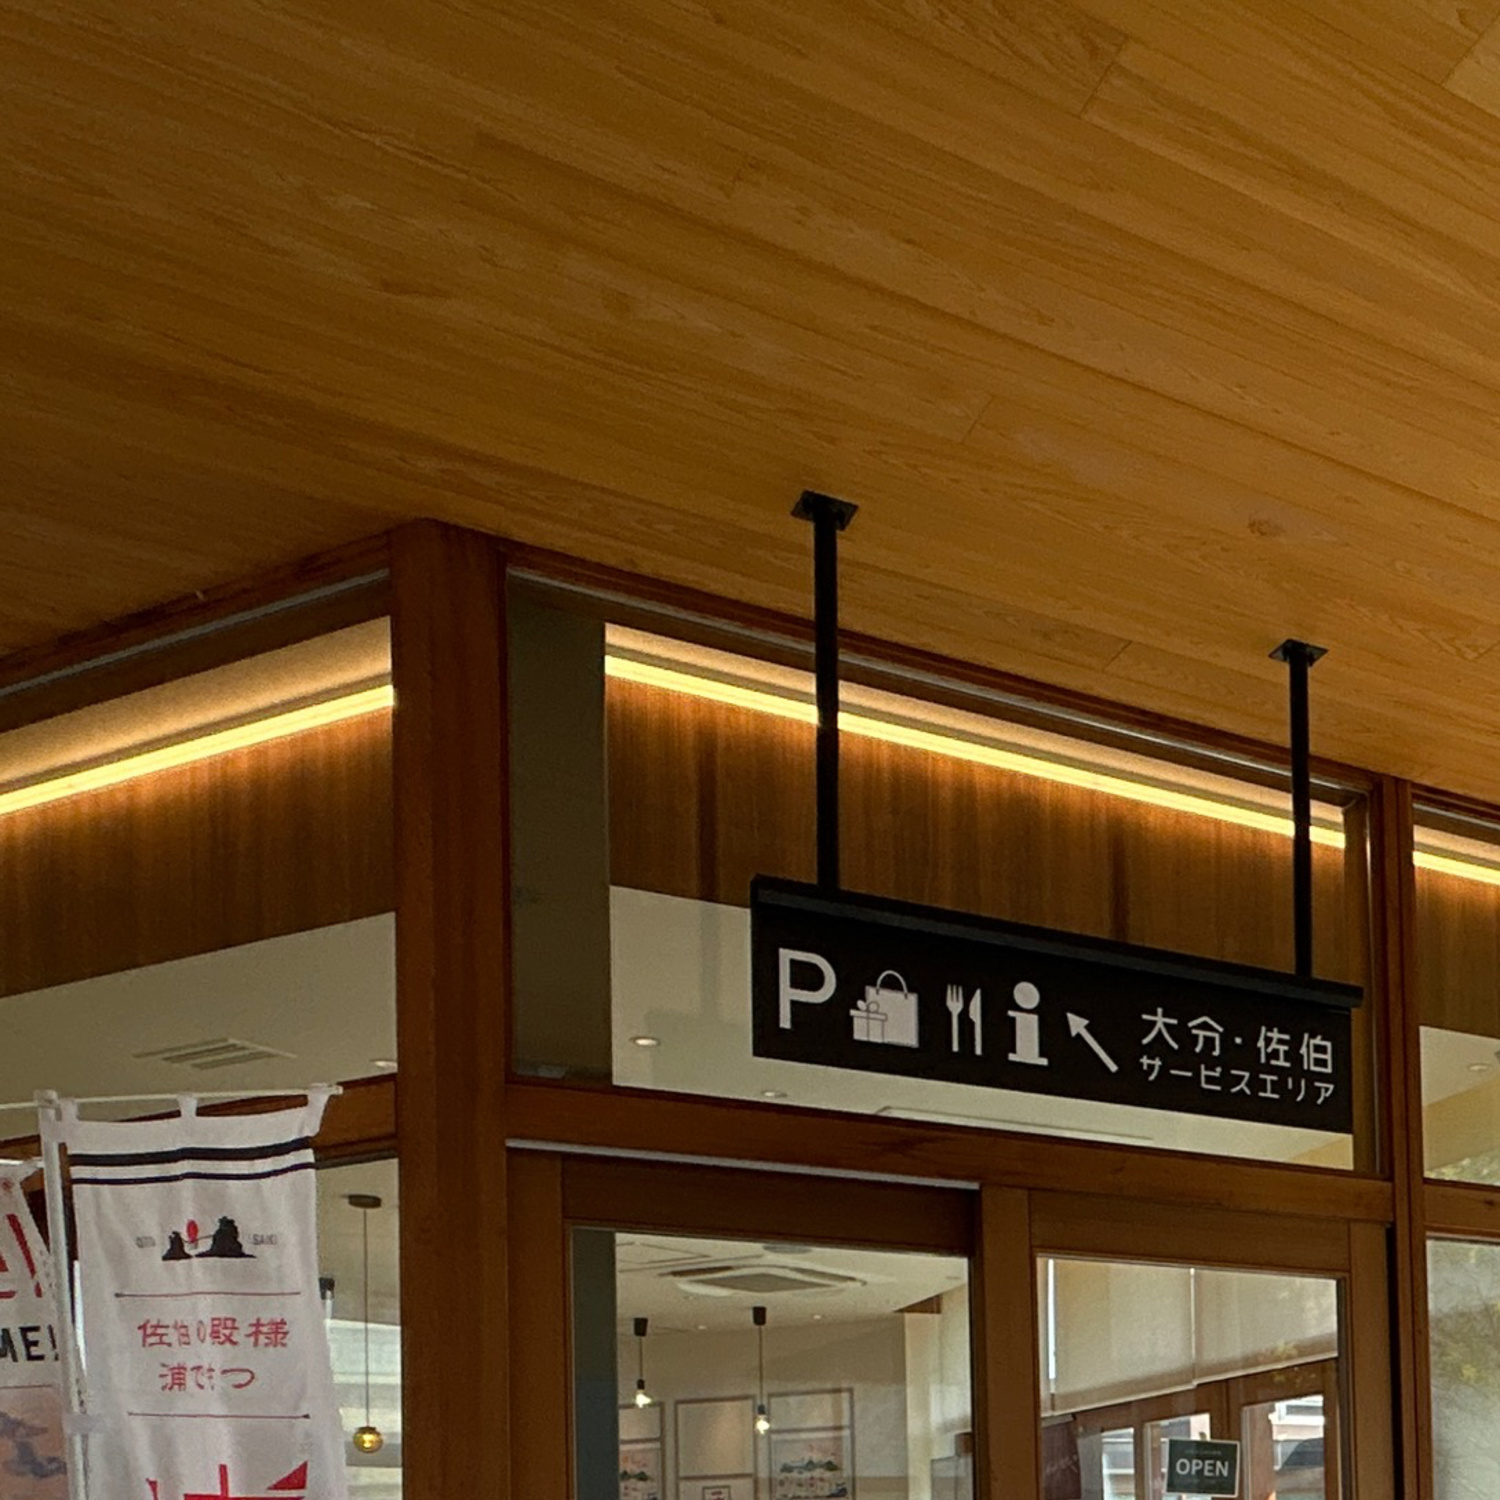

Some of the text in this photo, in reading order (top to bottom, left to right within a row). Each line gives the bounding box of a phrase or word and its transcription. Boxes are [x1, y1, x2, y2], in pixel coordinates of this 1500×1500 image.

[779, 948, 836, 1029] P
[1141, 1008, 1333, 1074] 大分・佐伯
[1140, 1055, 1334, 1104] サービスエリア
[1176, 1458, 1229, 1477] OPEN
